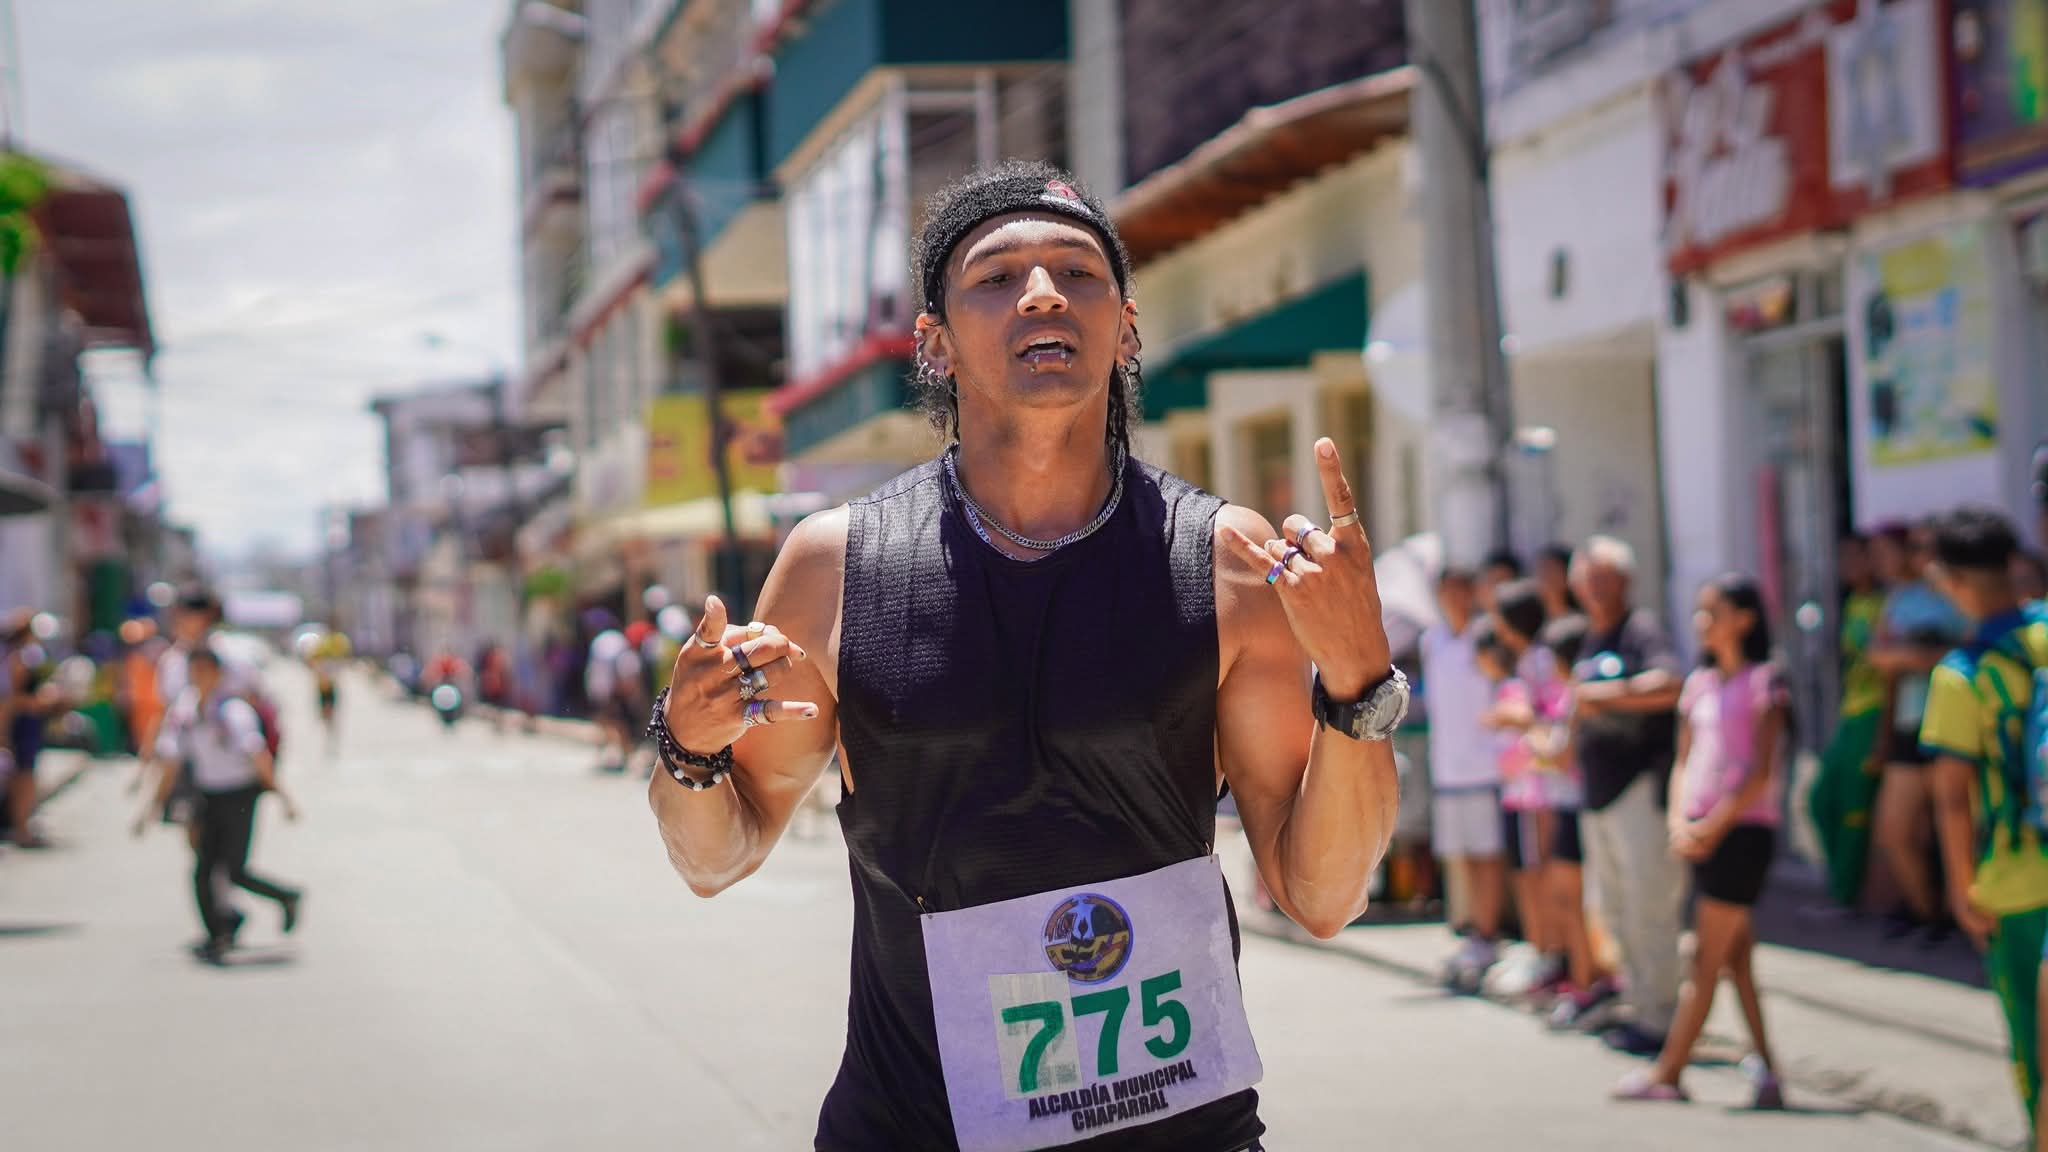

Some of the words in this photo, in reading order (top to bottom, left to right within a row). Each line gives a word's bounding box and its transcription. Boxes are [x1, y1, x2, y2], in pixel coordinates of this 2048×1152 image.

[1001, 969, 1191, 1093] 775
[1028, 1083, 1112, 1119] ALCALDÍA
[1112, 1059, 1197, 1101] MUNICIPAL
[1071, 1090, 1169, 1131] CHAPARRAL
